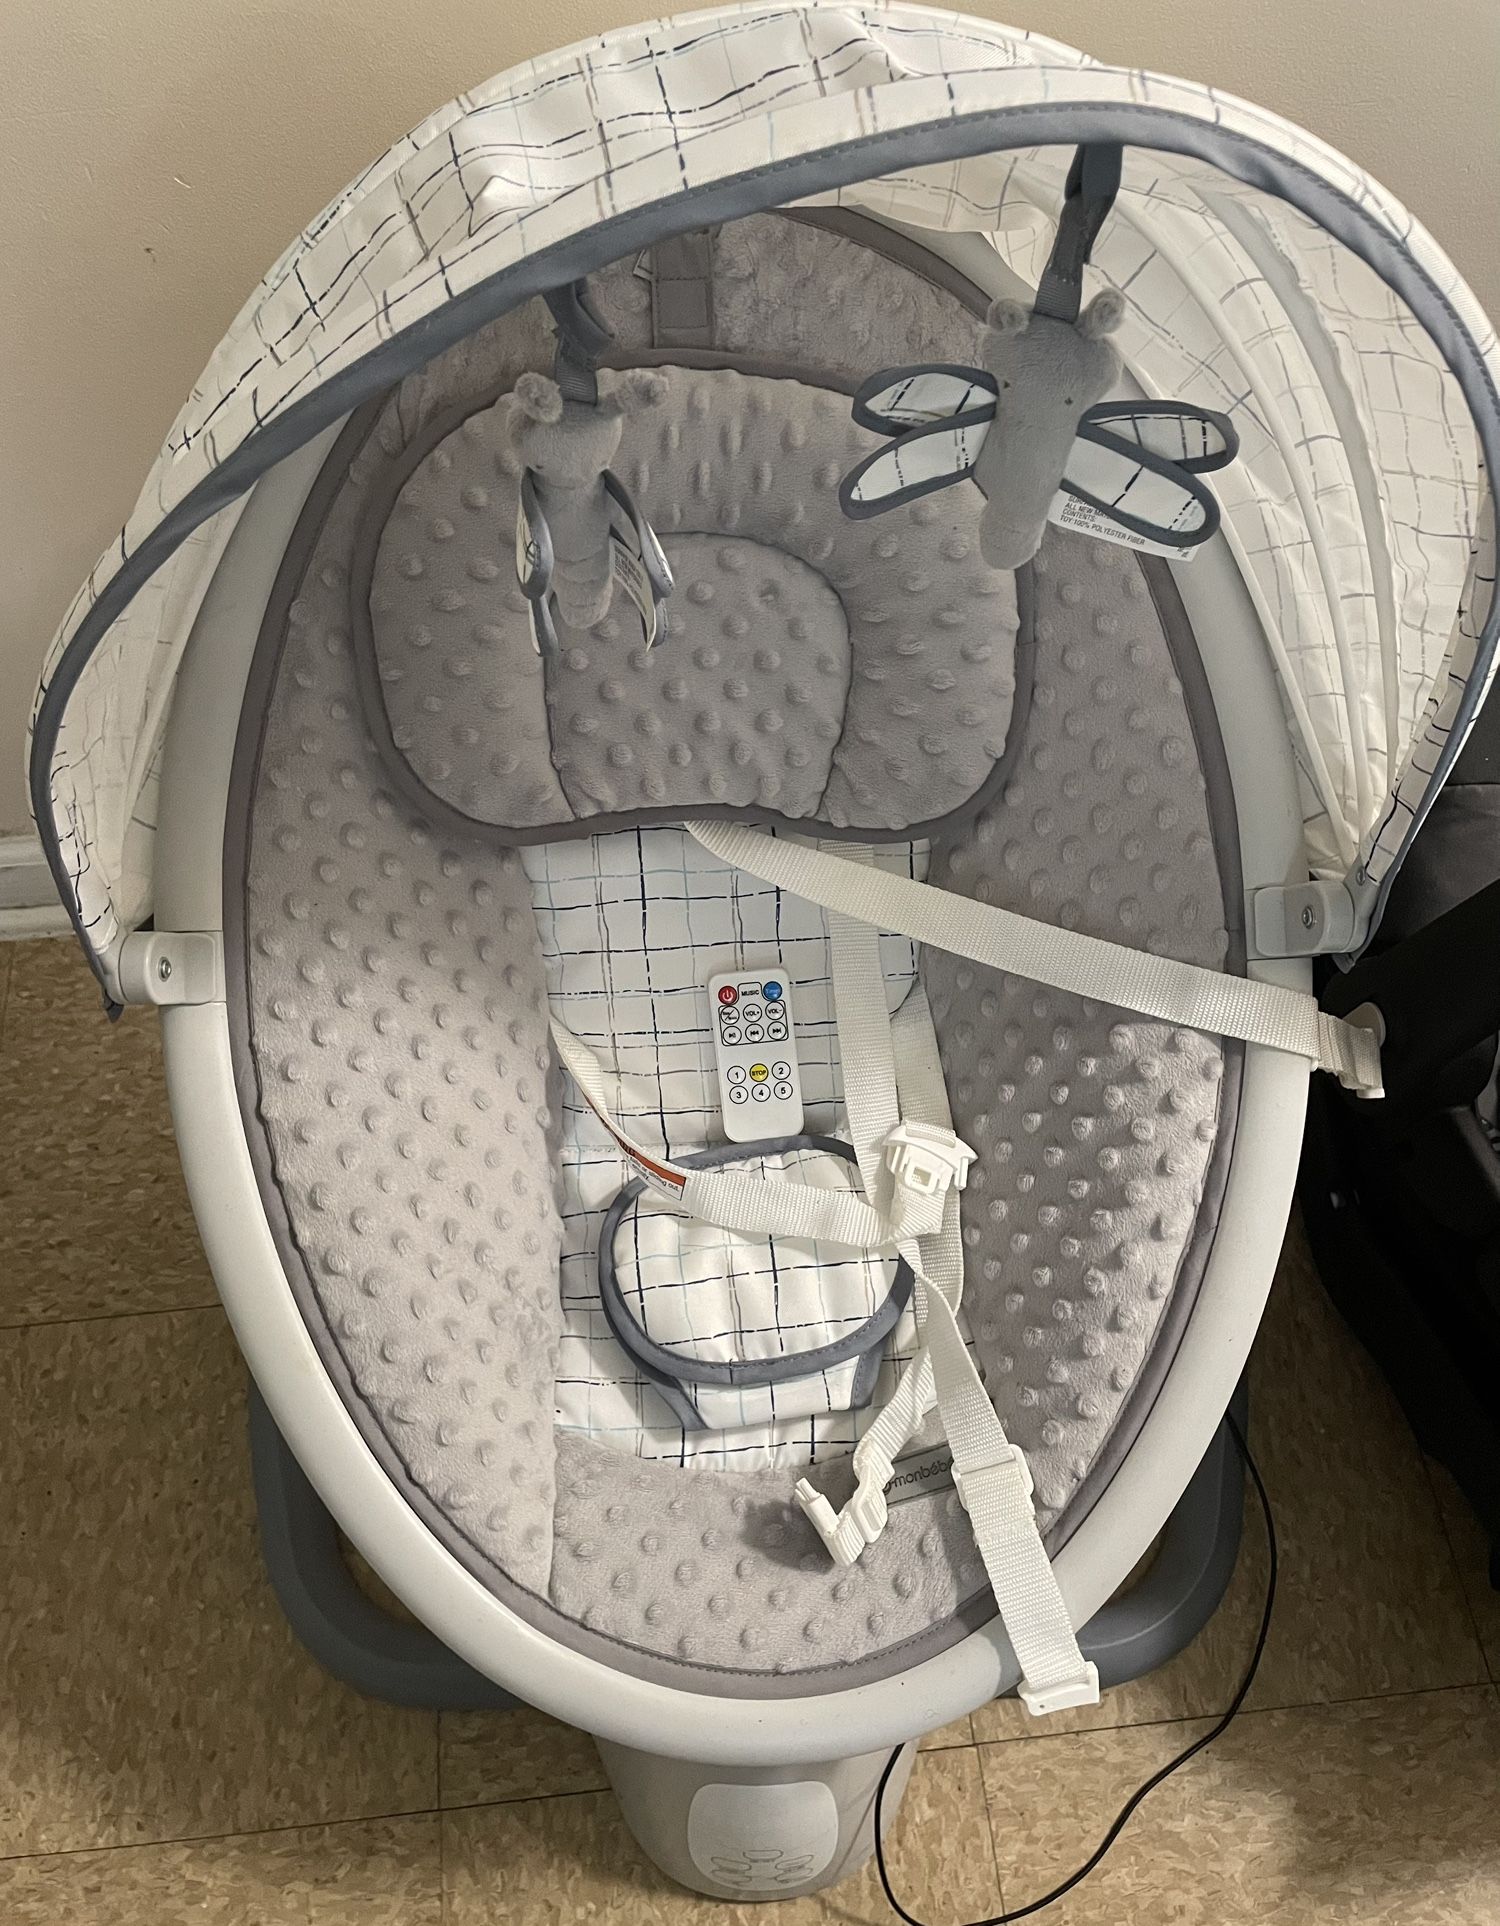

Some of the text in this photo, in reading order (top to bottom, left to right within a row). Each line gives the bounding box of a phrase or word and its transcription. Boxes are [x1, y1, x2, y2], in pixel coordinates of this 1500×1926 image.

[1065, 502, 1077, 511] ALL
[1079, 505, 1094, 514] NEW
[1091, 523, 1127, 540] POLYESTER
[1127, 534, 1146, 546] FIBER
[778, 1067, 784, 1075] 2
[736, 1091, 742, 1099] 3
